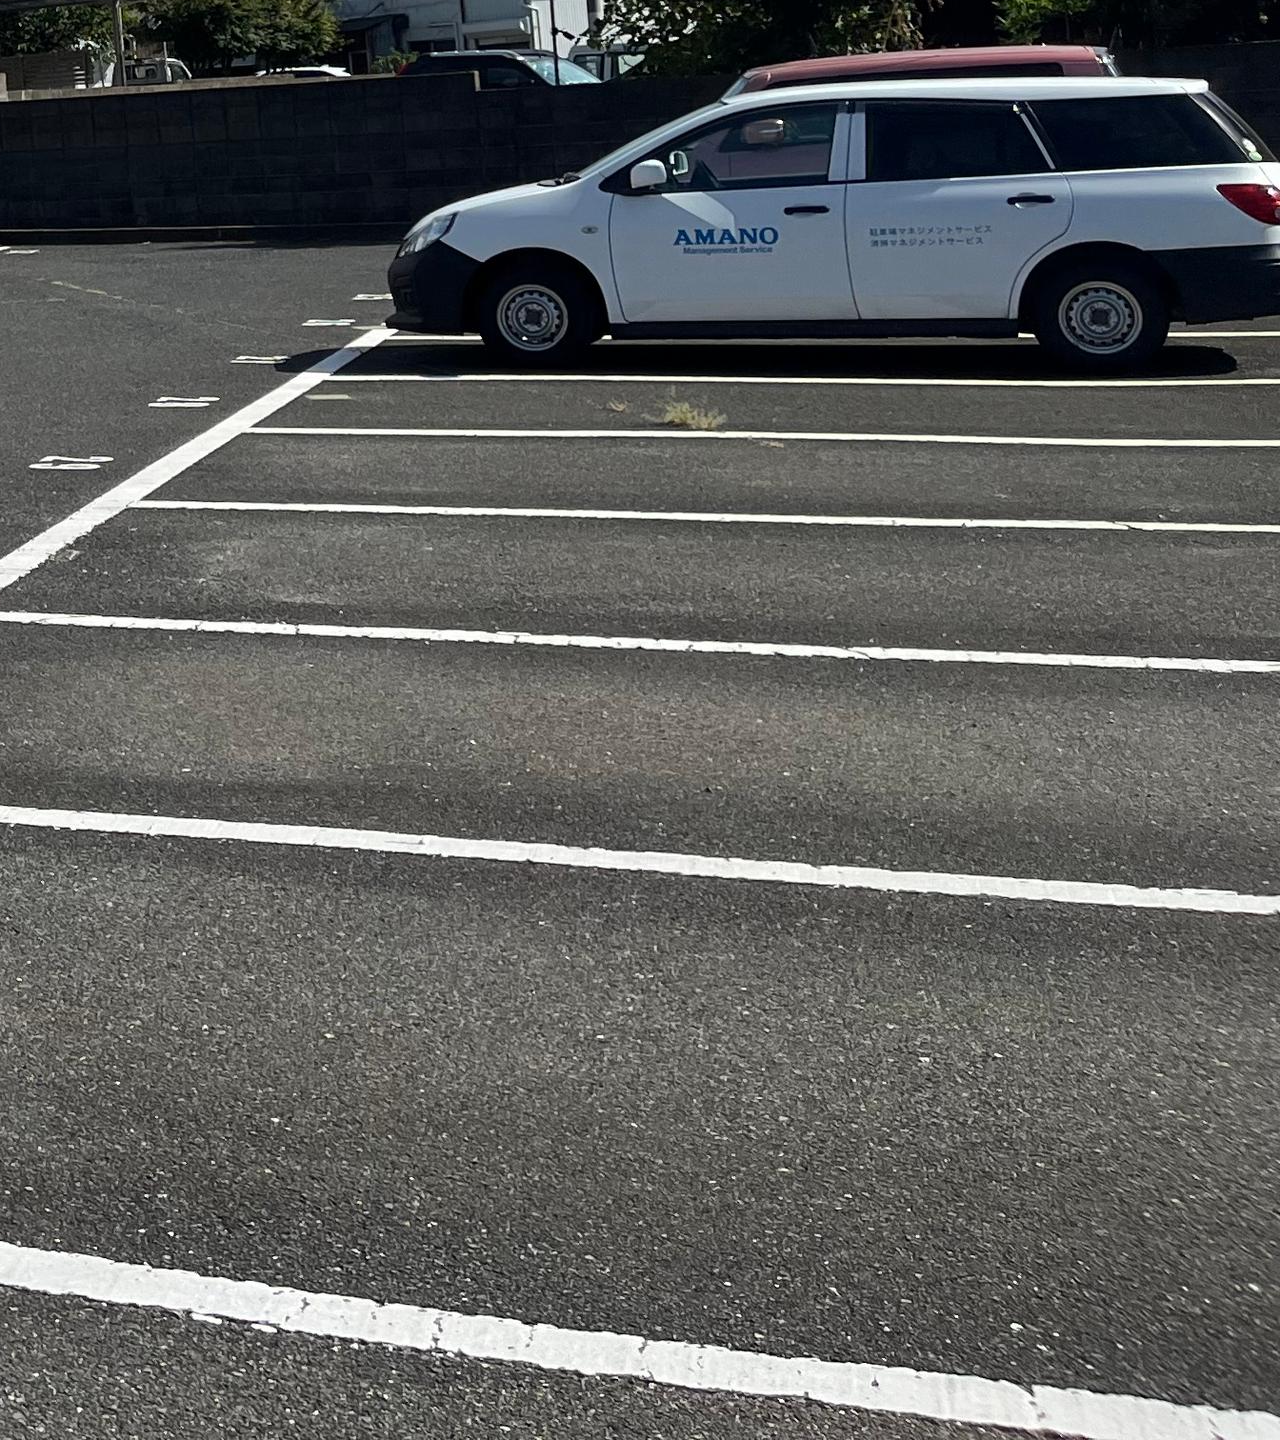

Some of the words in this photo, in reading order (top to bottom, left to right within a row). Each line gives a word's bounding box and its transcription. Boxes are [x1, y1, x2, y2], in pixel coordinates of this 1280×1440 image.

[673, 226, 779, 246] AMANO
[683, 246, 738, 256] Management
[739, 245, 773, 254] Service
